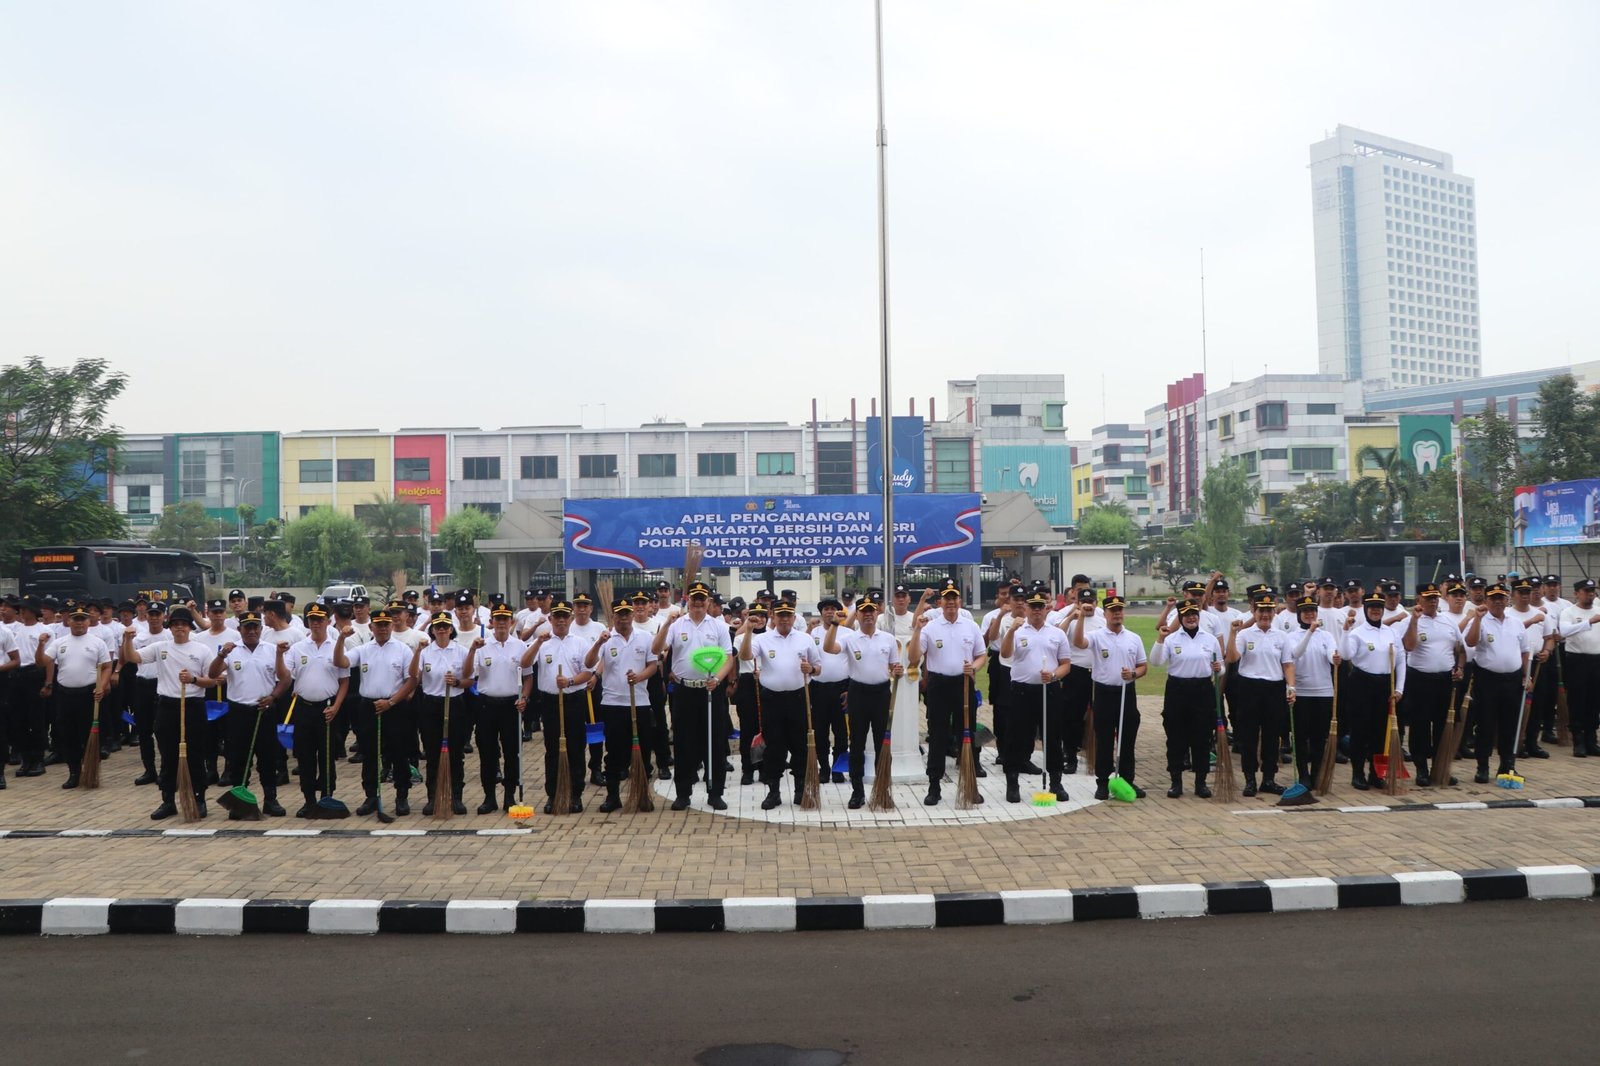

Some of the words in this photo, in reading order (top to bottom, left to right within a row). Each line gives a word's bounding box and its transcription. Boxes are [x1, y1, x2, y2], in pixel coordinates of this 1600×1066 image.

[1032, 492, 1058, 505] ental
[680, 513, 726, 524] APEL
[730, 511, 870, 523] PENCANANGAN
[641, 526, 687, 536] JAGA
[690, 525, 770, 535] JAKARTA
[773, 524, 834, 534] BERSIH
[837, 523, 873, 533] DAN
[638, 538, 702, 548] POLRES
[705, 536, 764, 547] METRO
[766, 535, 870, 546] TANGERANG
[874, 534, 918, 544] KTA
[755, 547, 818, 558] METRO
[821, 546, 868, 557] JAYA
